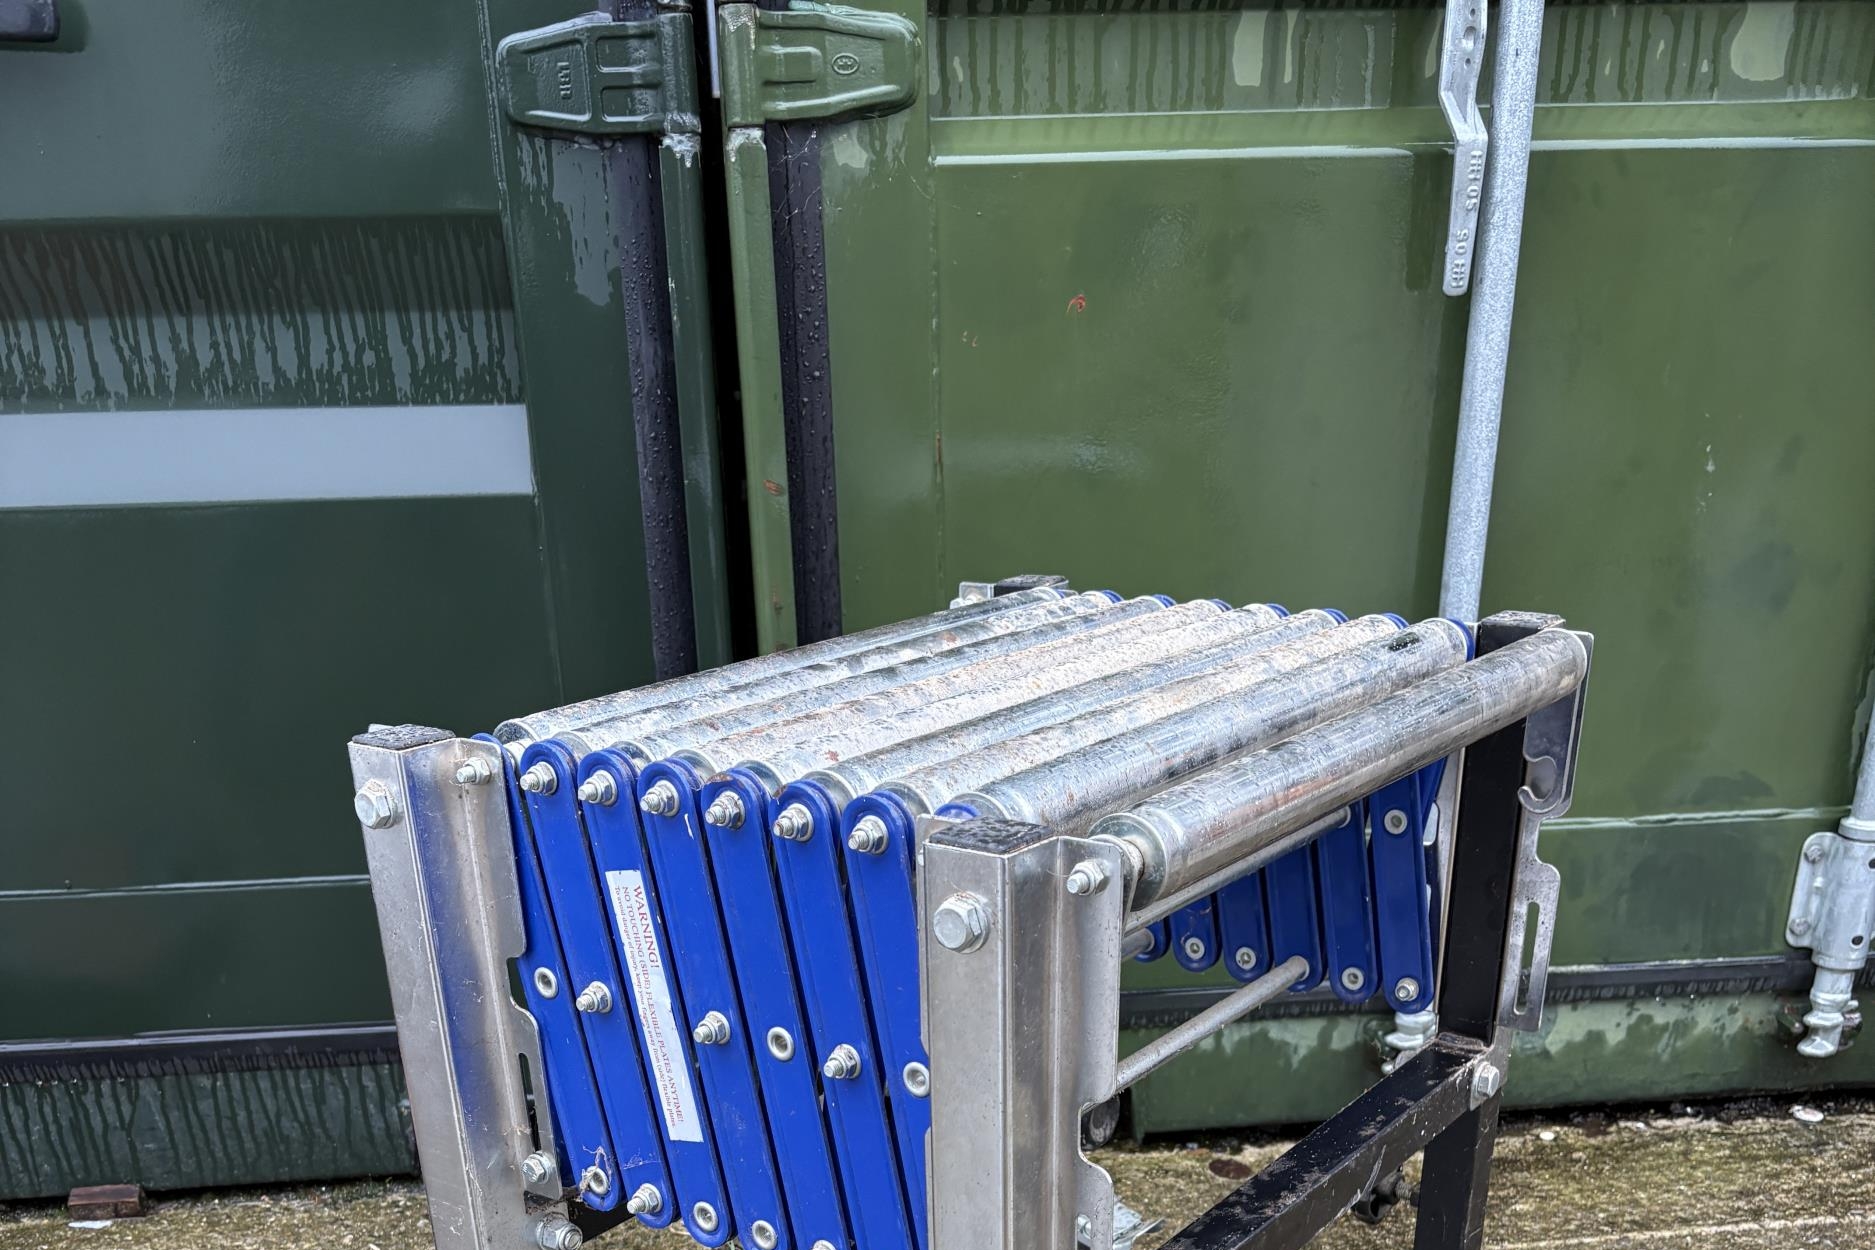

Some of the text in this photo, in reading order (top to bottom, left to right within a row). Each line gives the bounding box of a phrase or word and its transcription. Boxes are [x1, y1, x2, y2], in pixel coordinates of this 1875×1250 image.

[617, 897, 625, 916] avoid
[622, 916, 631, 940] danger
[662, 1083, 671, 1107] flexible
[623, 886, 684, 1122] NO TOUCHING (SIDE) FLEXIBLE PLATES ANYTIME!
[633, 884, 659, 968] WARNING!
